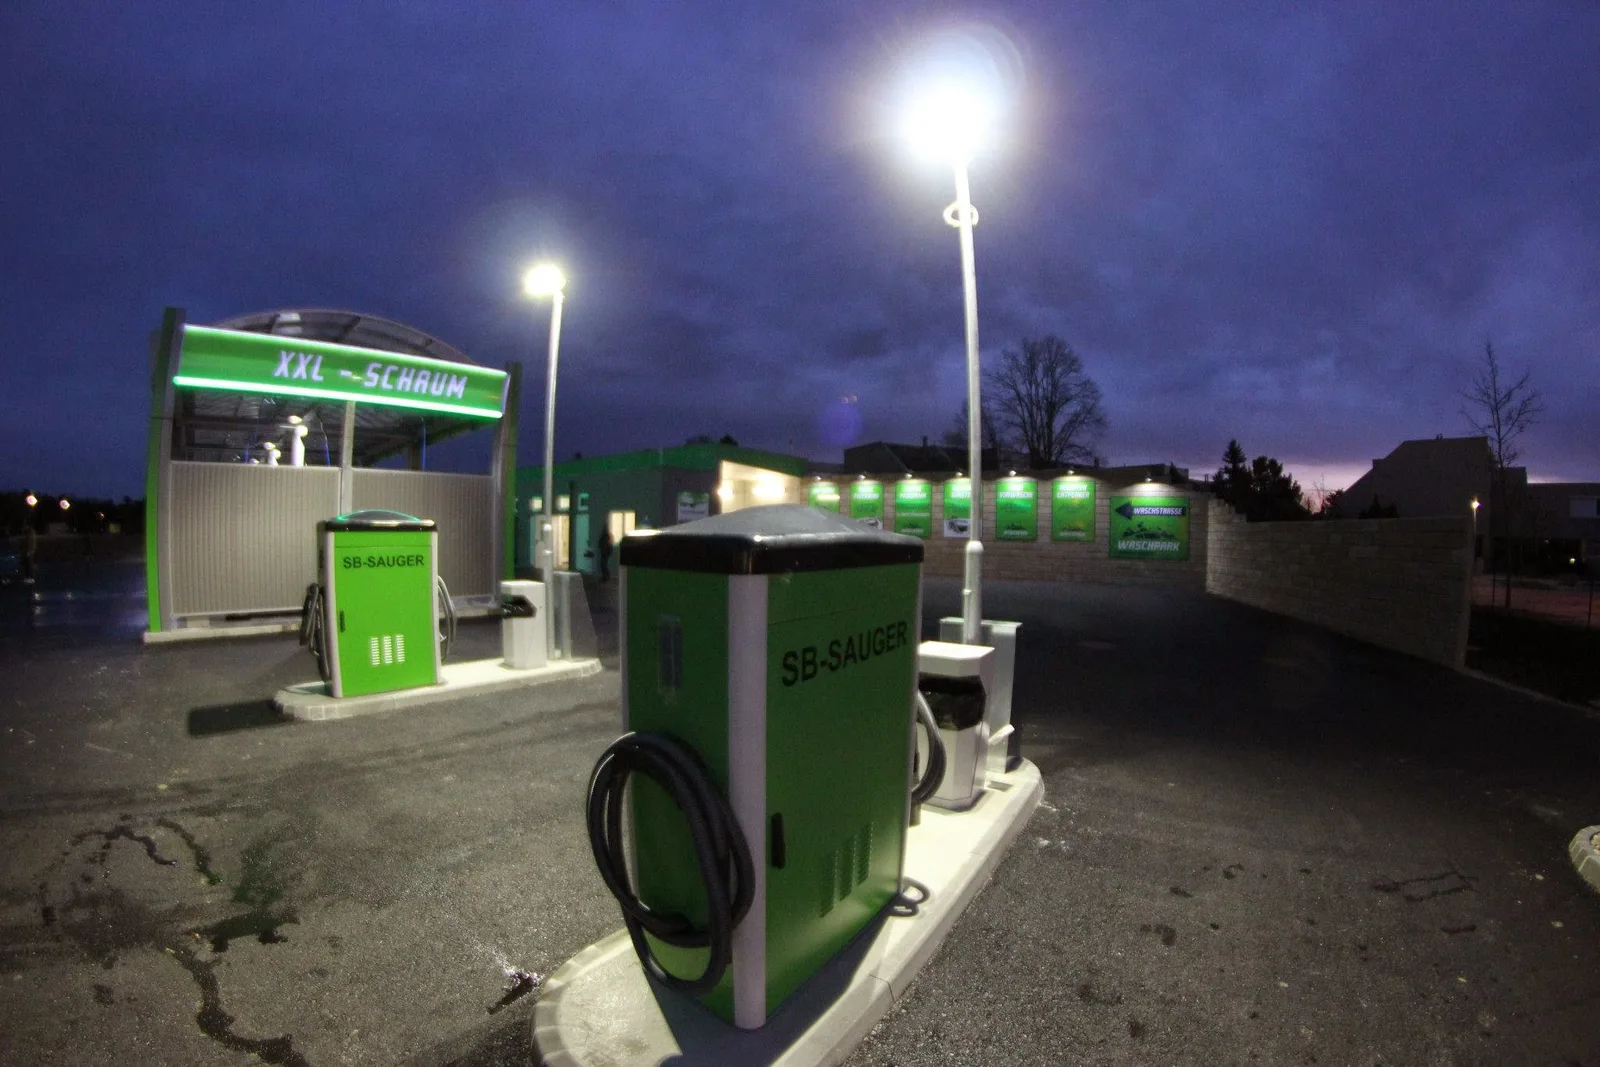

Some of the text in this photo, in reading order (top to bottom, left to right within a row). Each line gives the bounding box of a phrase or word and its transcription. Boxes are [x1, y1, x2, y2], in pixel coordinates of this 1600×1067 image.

[274, 351, 324, 381] XXL
[363, 362, 468, 399] SCHAUM
[1133, 507, 1183, 515] WASCHSTRASSE
[1118, 540, 1181, 551] WASCHPARK
[342, 554, 425, 569] SB-SAUGER
[781, 620, 909, 687] SB-SAUGER
